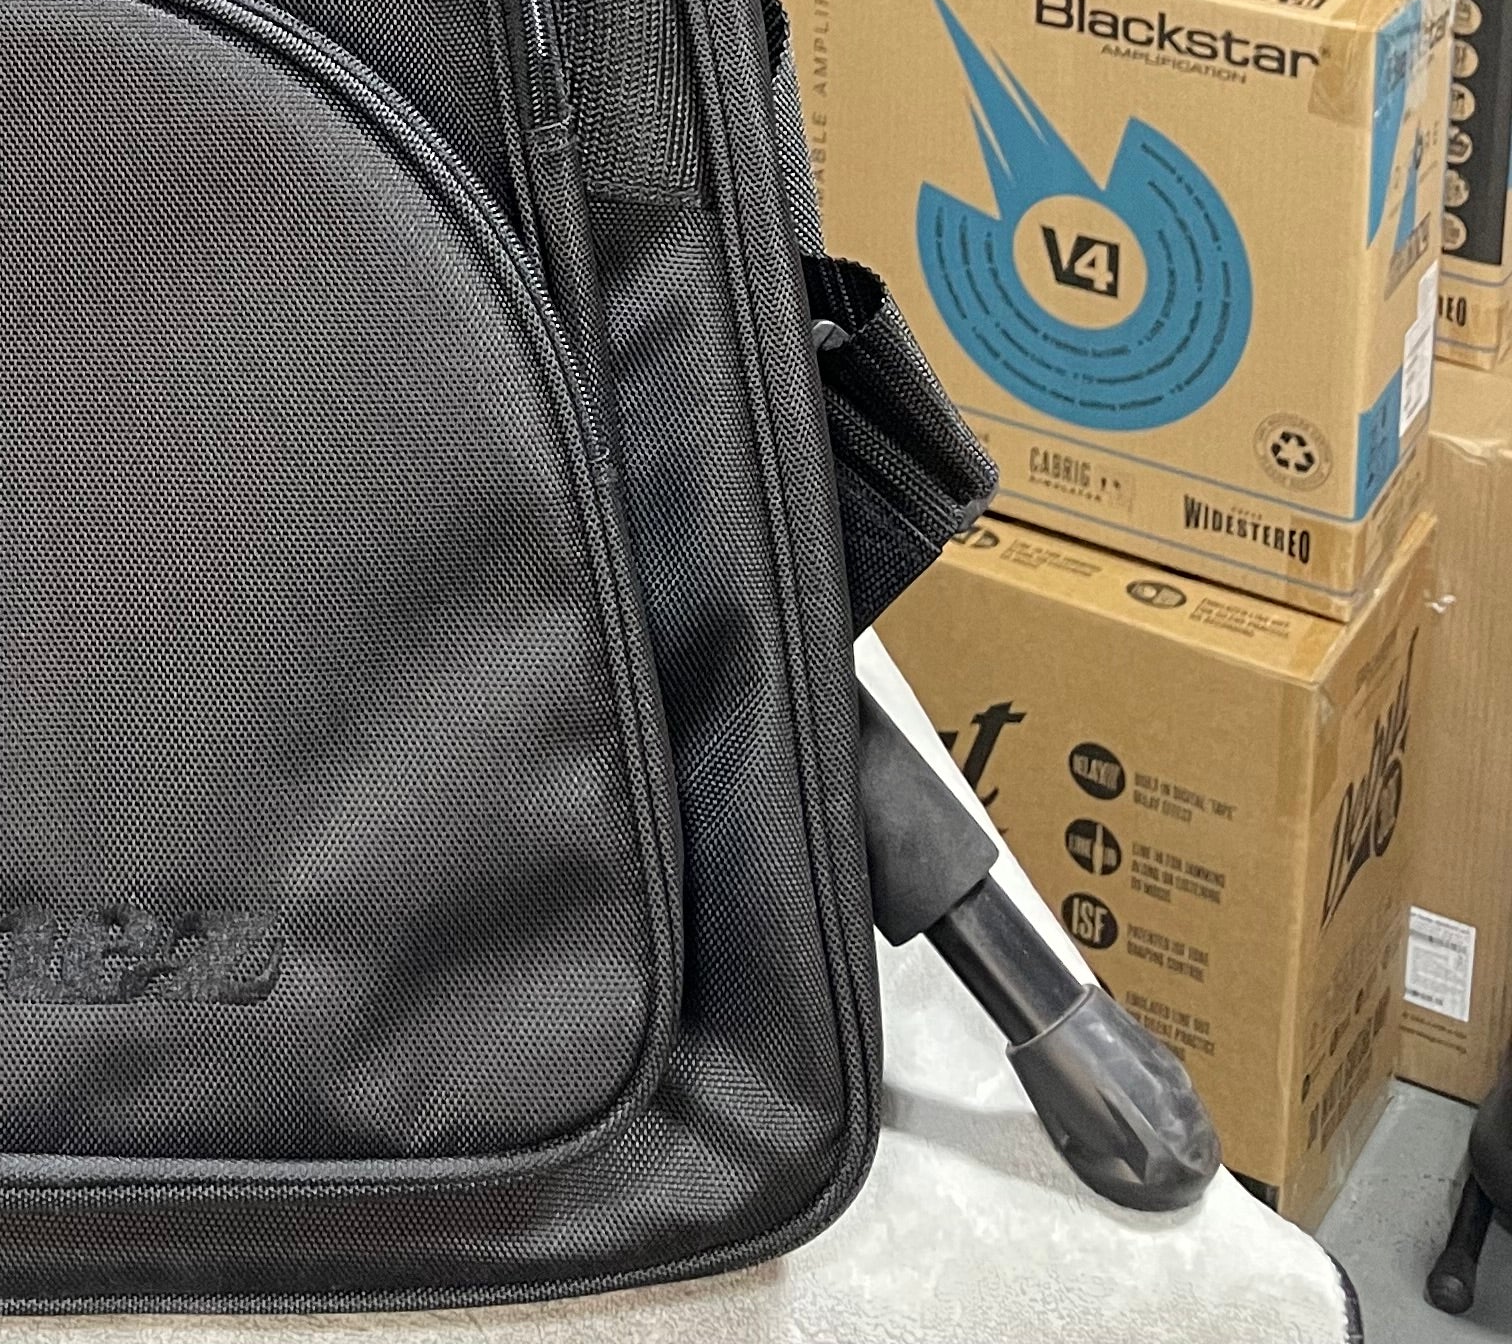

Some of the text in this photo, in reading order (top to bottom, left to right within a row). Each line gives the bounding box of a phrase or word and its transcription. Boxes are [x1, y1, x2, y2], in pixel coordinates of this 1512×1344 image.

[1099, 42, 1247, 86] AMPLIFICATION
[1040, 224, 1121, 300] V4
[1029, 446, 1091, 487] CABRIG
[1182, 493, 1312, 566] WIDESTEREO
[1070, 895, 1107, 946] ISF
